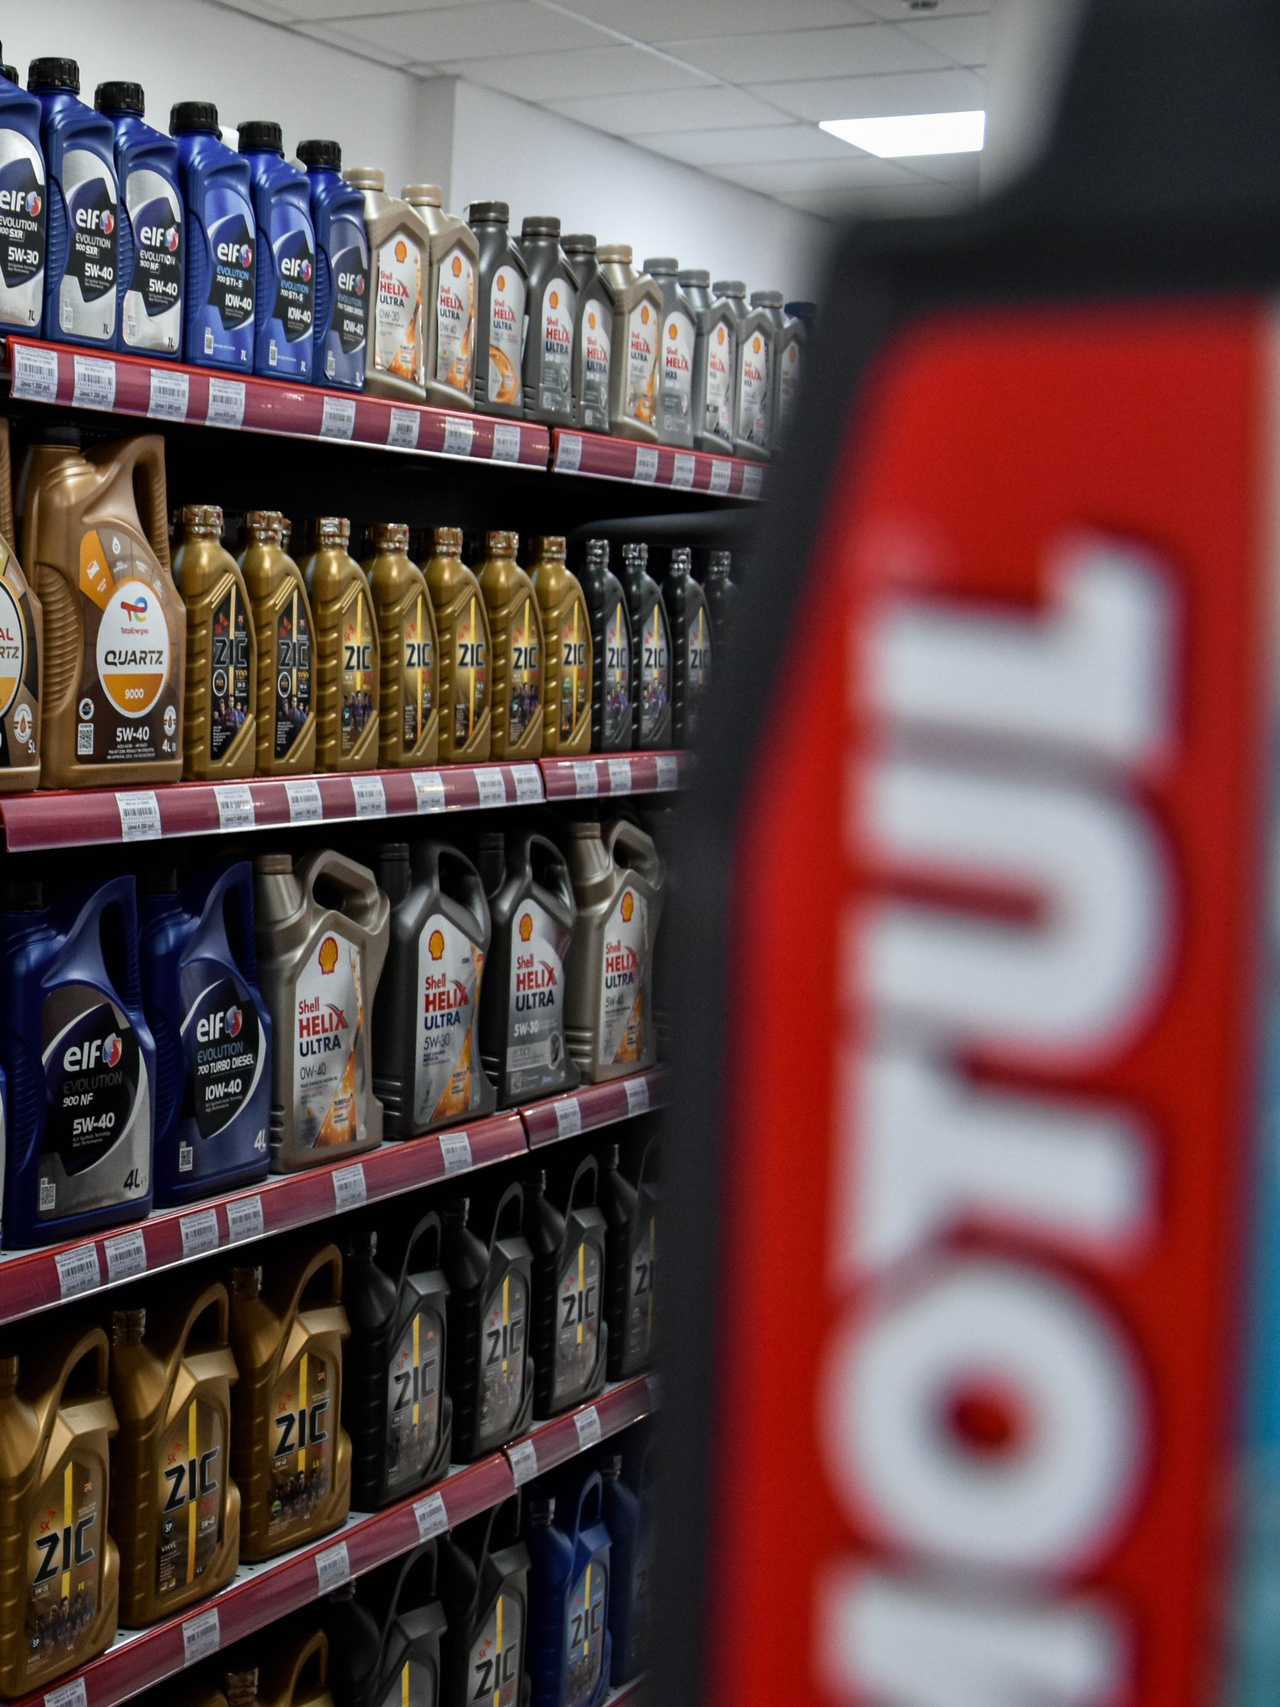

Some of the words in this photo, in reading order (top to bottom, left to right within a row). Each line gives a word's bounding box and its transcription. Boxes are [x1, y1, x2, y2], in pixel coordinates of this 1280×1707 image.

[76, 208, 99, 228] elf
[10, 229, 24, 240] SXR
[140, 226, 164, 246] elf
[8, 246, 38, 264] 5W-30
[217, 243, 240, 262] elf
[84, 262, 113, 280] 5W-40
[281, 258, 301, 276] elf
[149, 278, 178, 296] 5W-40
[338, 274, 354, 289] elf
[380, 280, 409, 298] HELIX
[225, 294, 252, 310] 10W-40
[380, 294, 404, 308] ULTRA
[440, 294, 463, 310] HELIX
[288, 306, 311, 323] 10W-40
[440, 308, 460, 320] ULTRA
[546, 327, 570, 343] HELIX
[104, 650, 163, 666] QUARTZ
[214, 637, 250, 667] ZIC
[279, 640, 309, 667] ZIC
[344, 646, 372, 670] ZIC
[406, 643, 432, 668] ZIC
[458, 643, 486, 667] ZIC
[513, 646, 538, 670] ZIC
[562, 643, 587, 666] ZIC
[608, 647, 626, 668] ZIC
[644, 648, 666, 668] ZIC
[125, 688, 144, 700] 9000
[116, 727, 150, 742] 5W-40
[606, 942, 621, 956] Shell
[516, 955, 534, 970] Shell
[606, 948, 638, 972] HELIX
[425, 974, 446, 990] Shell
[516, 961, 556, 992] HELIX
[605, 972, 634, 988] ULTRA
[424, 980, 469, 1013] HELIX
[516, 990, 554, 1011] ULTRA
[298, 1000, 319, 1014] Shell
[196, 1014, 224, 1042] elf
[298, 1008, 348, 1038] HELIX
[424, 1010, 460, 1030] ULTRA
[514, 1020, 538, 1036] 5W-30
[64, 1040, 101, 1072] elf
[197, 1042, 243, 1062] EVOLUTION
[299, 1036, 341, 1057] ULTRA
[205, 1079, 242, 1100] 10W-40
[73, 1112, 114, 1135] 5W-40
[562, 1285, 596, 1329] ZIC
[486, 1318, 522, 1367] ZIC
[394, 1358, 436, 1412] ZIC
[274, 1401, 328, 1460] ZIC
[164, 1446, 219, 1516] ZIC
[33, 1513, 96, 1586] ZIC
[571, 1600, 603, 1649] ZIC
[474, 1642, 517, 1700] ZIC
